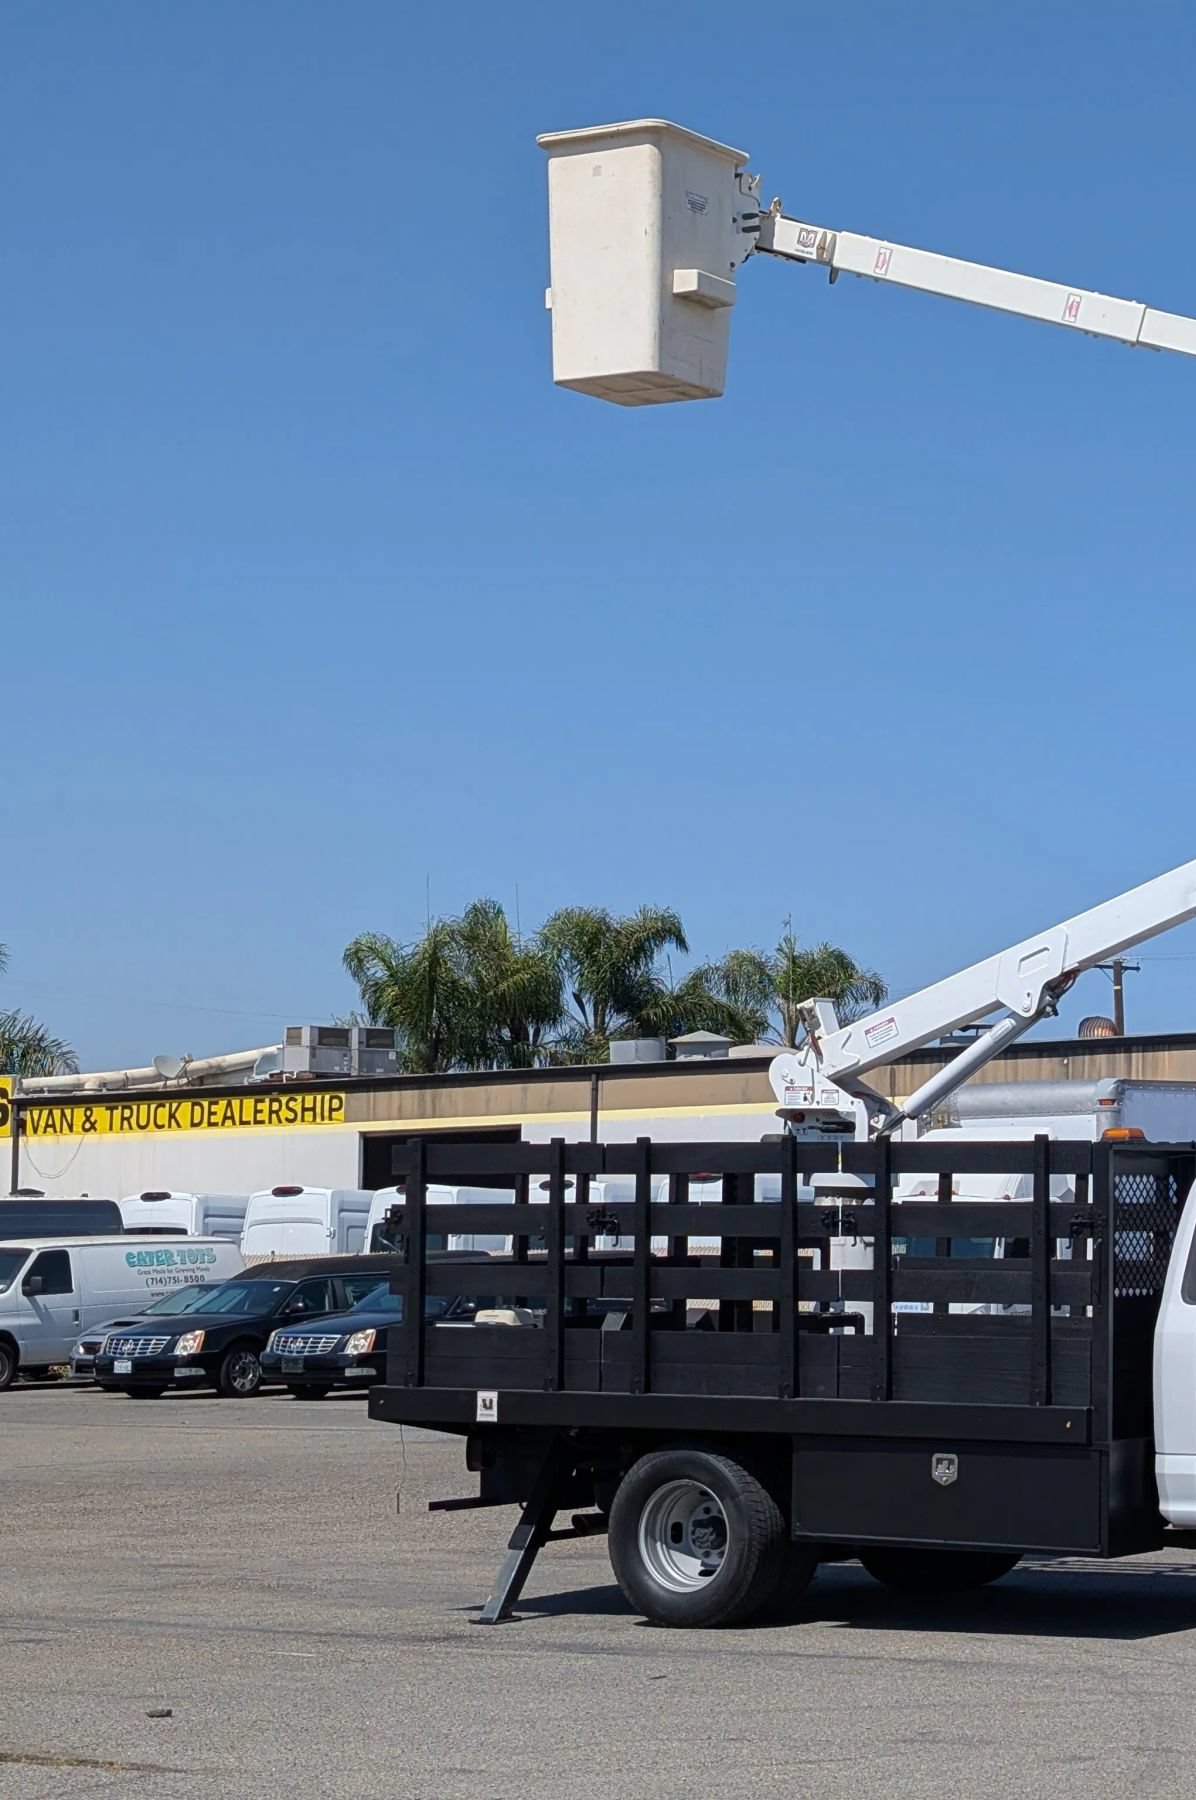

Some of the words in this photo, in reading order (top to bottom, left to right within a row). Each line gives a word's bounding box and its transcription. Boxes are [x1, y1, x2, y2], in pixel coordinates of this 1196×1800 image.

[29, 1107, 74, 1134] VAN
[81, 1106, 98, 1132] &
[105, 1101, 183, 1131] TRUCK
[189, 1095, 344, 1128] DEALERSHIP
